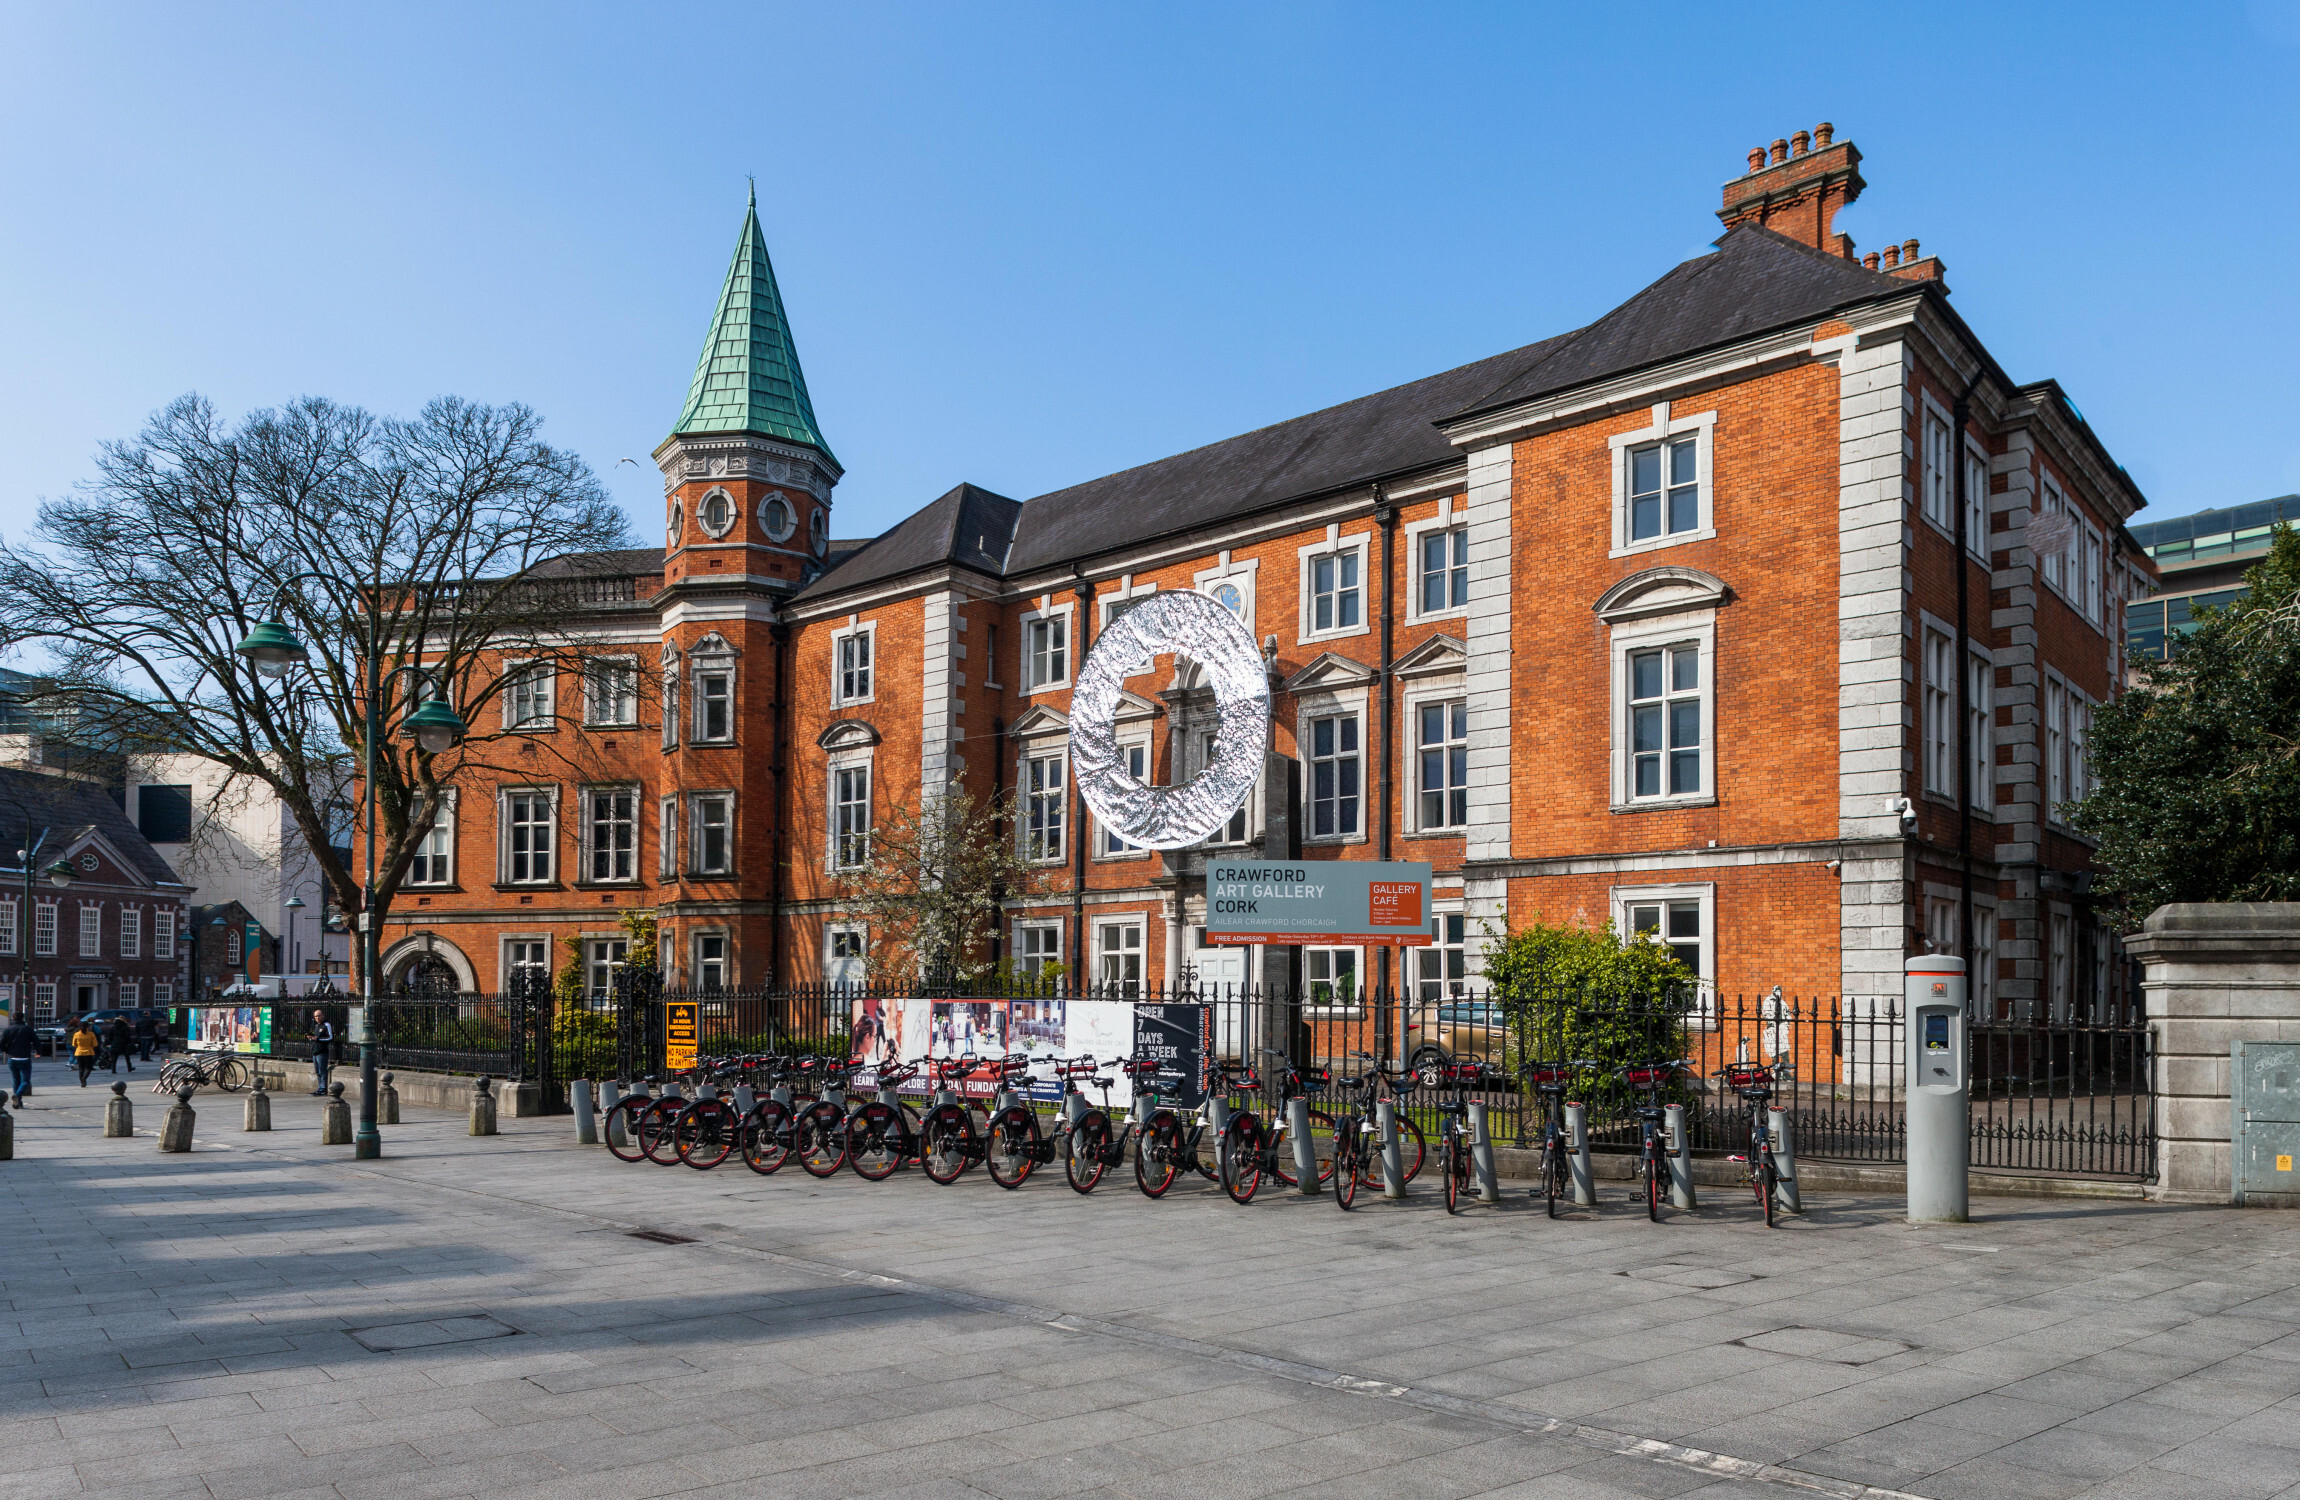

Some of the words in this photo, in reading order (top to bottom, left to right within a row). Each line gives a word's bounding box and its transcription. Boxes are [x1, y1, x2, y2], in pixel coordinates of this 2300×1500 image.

[1215, 868, 1306, 882] CRAWFORD
[1215, 884, 1247, 898] ART
[1252, 885, 1325, 899] GALLERY
[1373, 884, 1416, 894] GALLERY
[1373, 894, 1398, 905] CAFÉ
[1215, 900, 1258, 913] CORK
[1245, 918, 1289, 926] CRAWFORD
[1292, 918, 1336, 926] CHORCAIGH
[1138, 1006, 1164, 1018] OPEN
[1138, 1018, 1144, 1030] 7
[1138, 1032, 1164, 1044] DAYS
[668, 1048, 674, 1056] NO
[675, 1048, 696, 1056] PARKING
[1137, 1045, 1145, 1057] A
[1148, 1046, 1178, 1058] WEEK
[854, 1075, 874, 1086] LEARN
